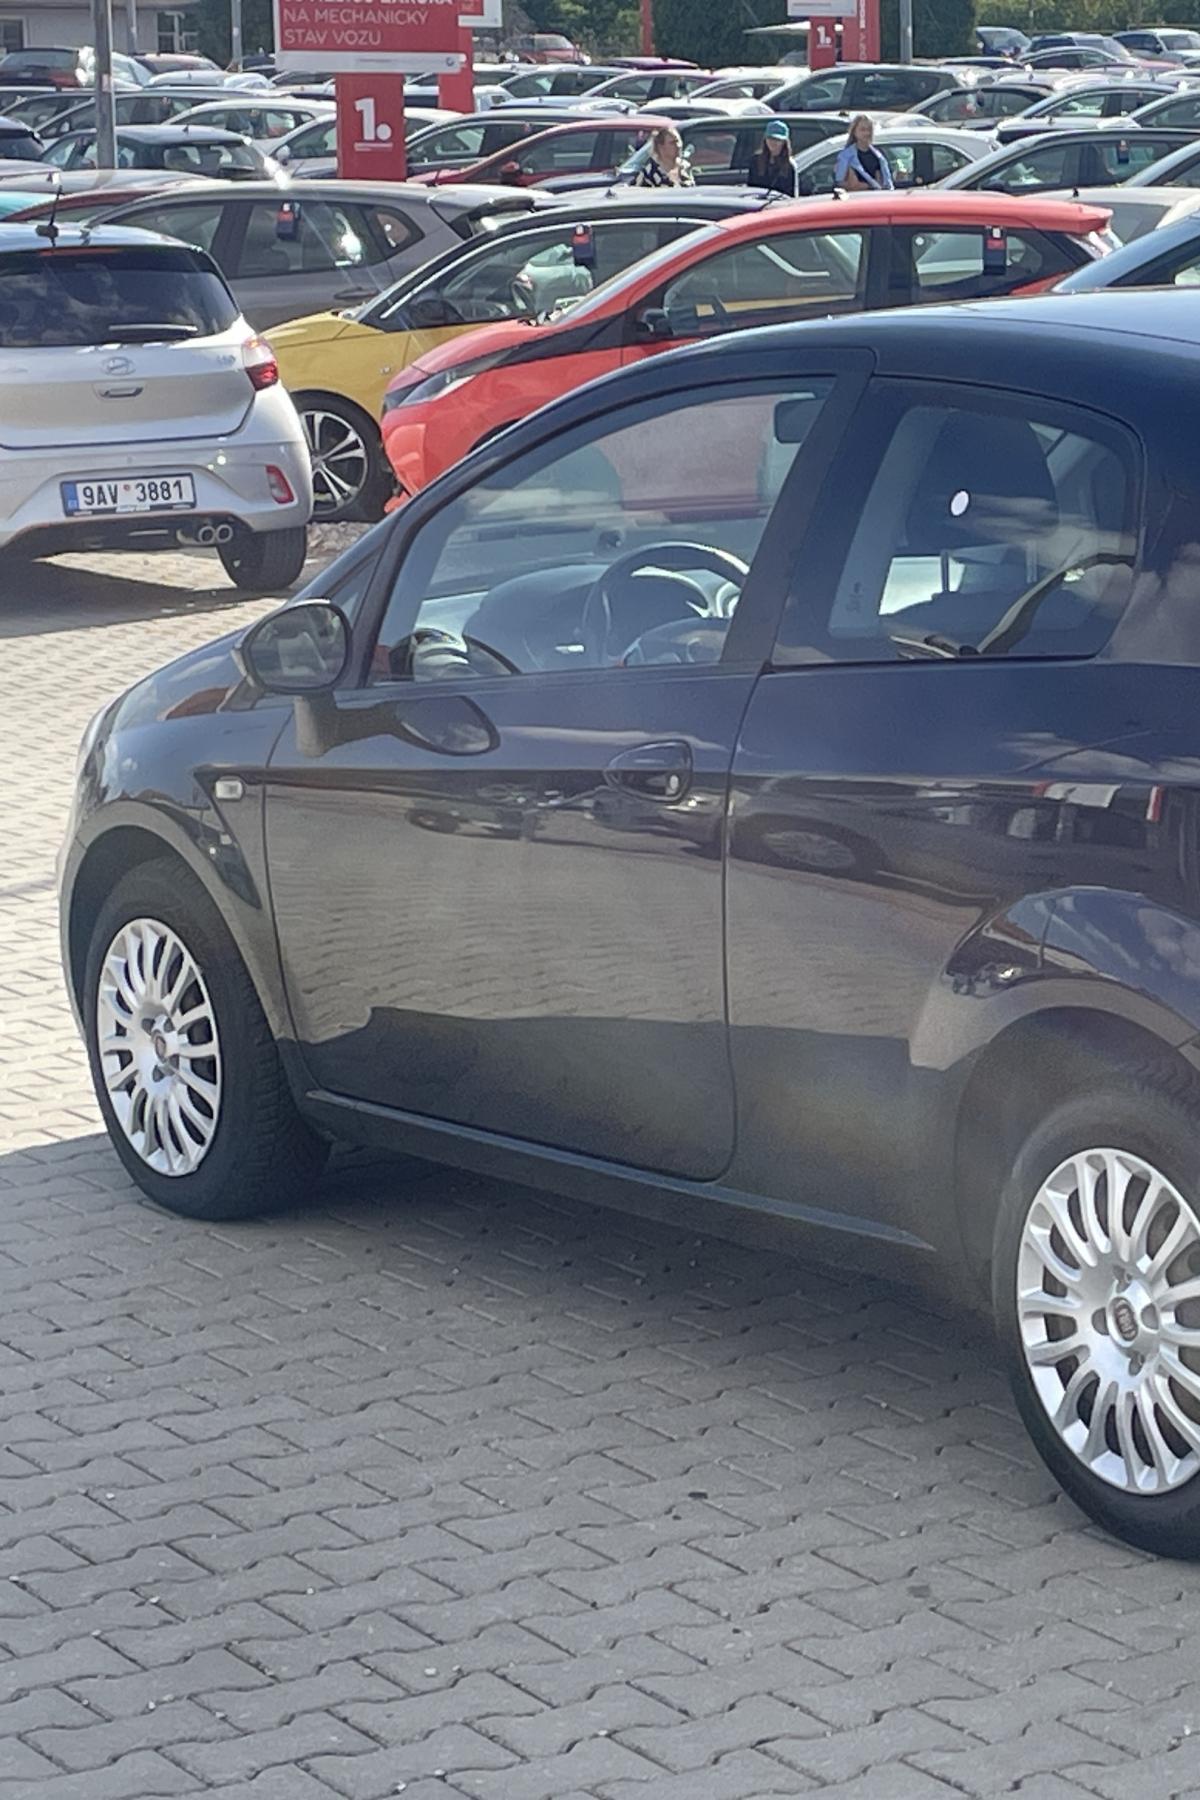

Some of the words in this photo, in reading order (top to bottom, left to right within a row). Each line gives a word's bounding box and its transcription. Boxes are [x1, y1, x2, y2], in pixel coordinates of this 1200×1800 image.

[283, 9, 309, 23] NA
[284, 30, 327, 45] STAV
[333, 30, 382, 46] VOZU
[82, 485, 118, 506] 9AV
[135, 480, 183, 502] 3881
